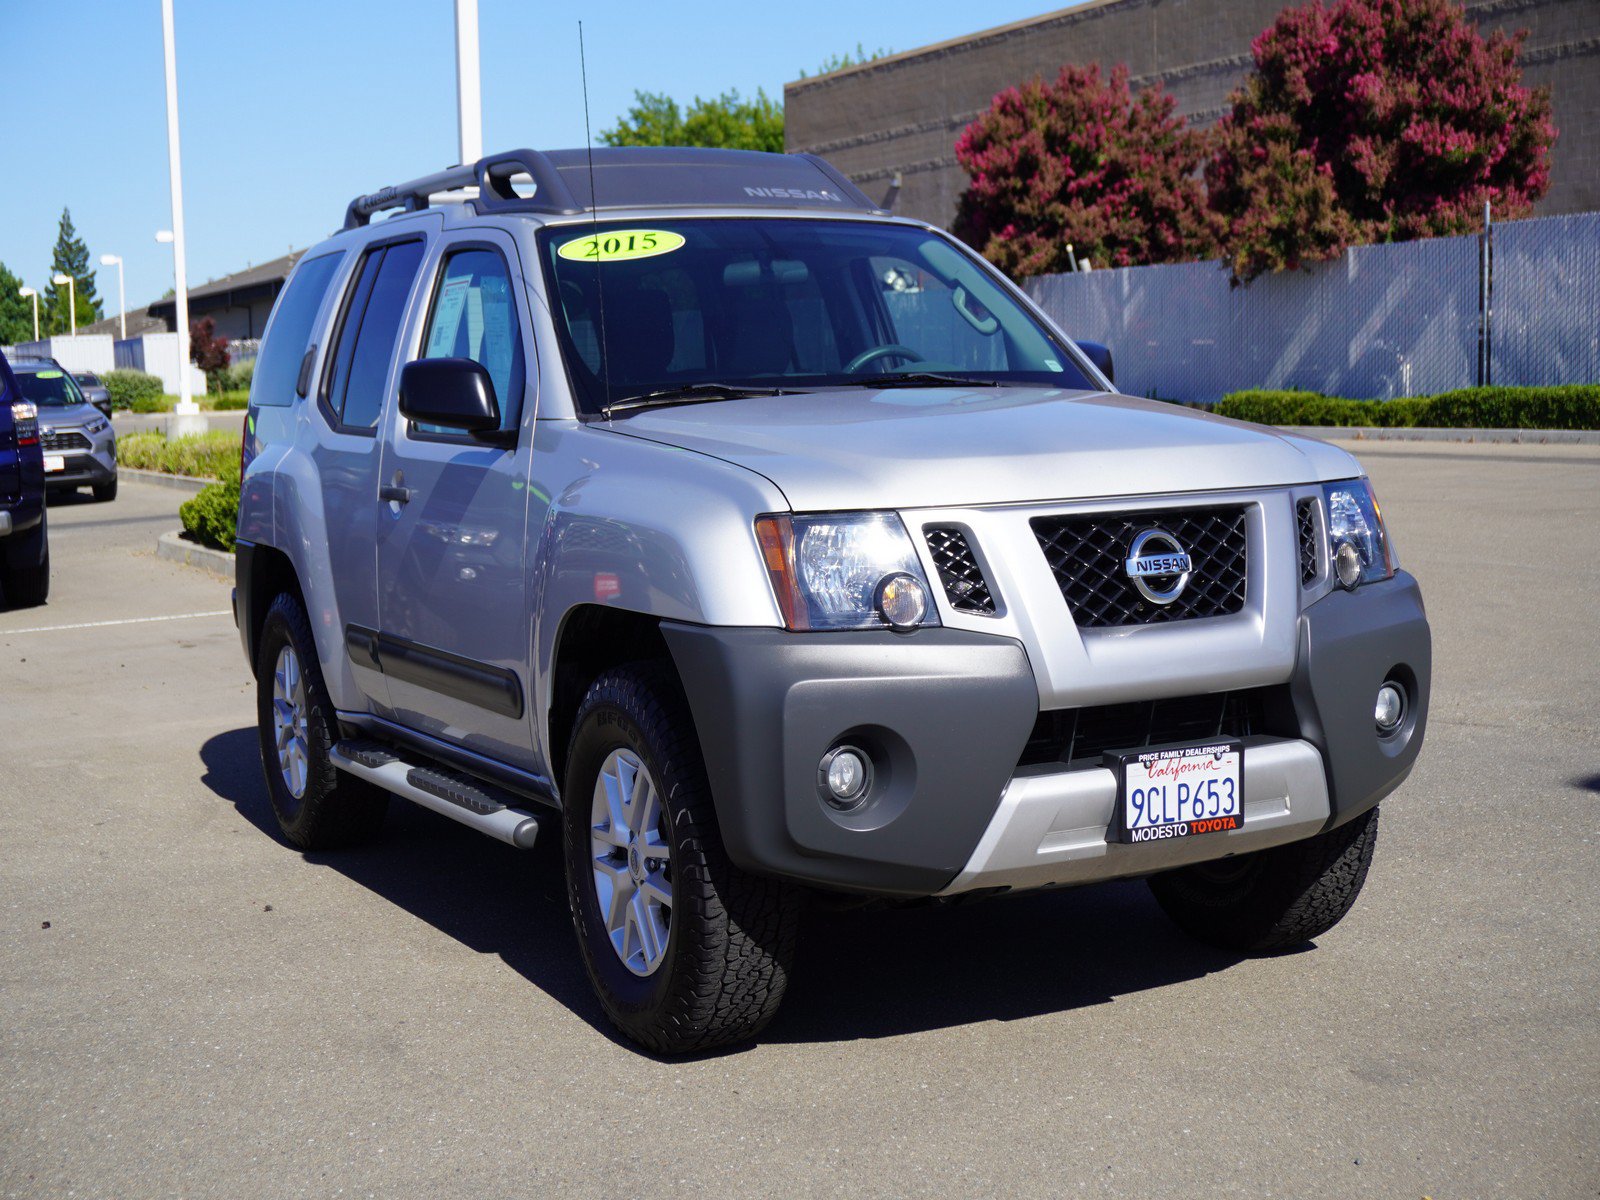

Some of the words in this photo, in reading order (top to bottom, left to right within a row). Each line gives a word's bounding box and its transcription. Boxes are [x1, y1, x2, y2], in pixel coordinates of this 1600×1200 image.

[743, 187, 842, 202] NISSAN
[583, 233, 657, 257] 2015
[1136, 557, 1188, 572] NISSAN
[1138, 753, 1159, 762] PRICE
[1160, 749, 1184, 759] FAMILY
[1185, 745, 1230, 756] DEALERSHIPS
[1148, 758, 1221, 781] California
[1131, 777, 1235, 828] 9CLP653
[1131, 823, 1188, 842] MODESTO
[1191, 817, 1237, 834] TOYOTA
